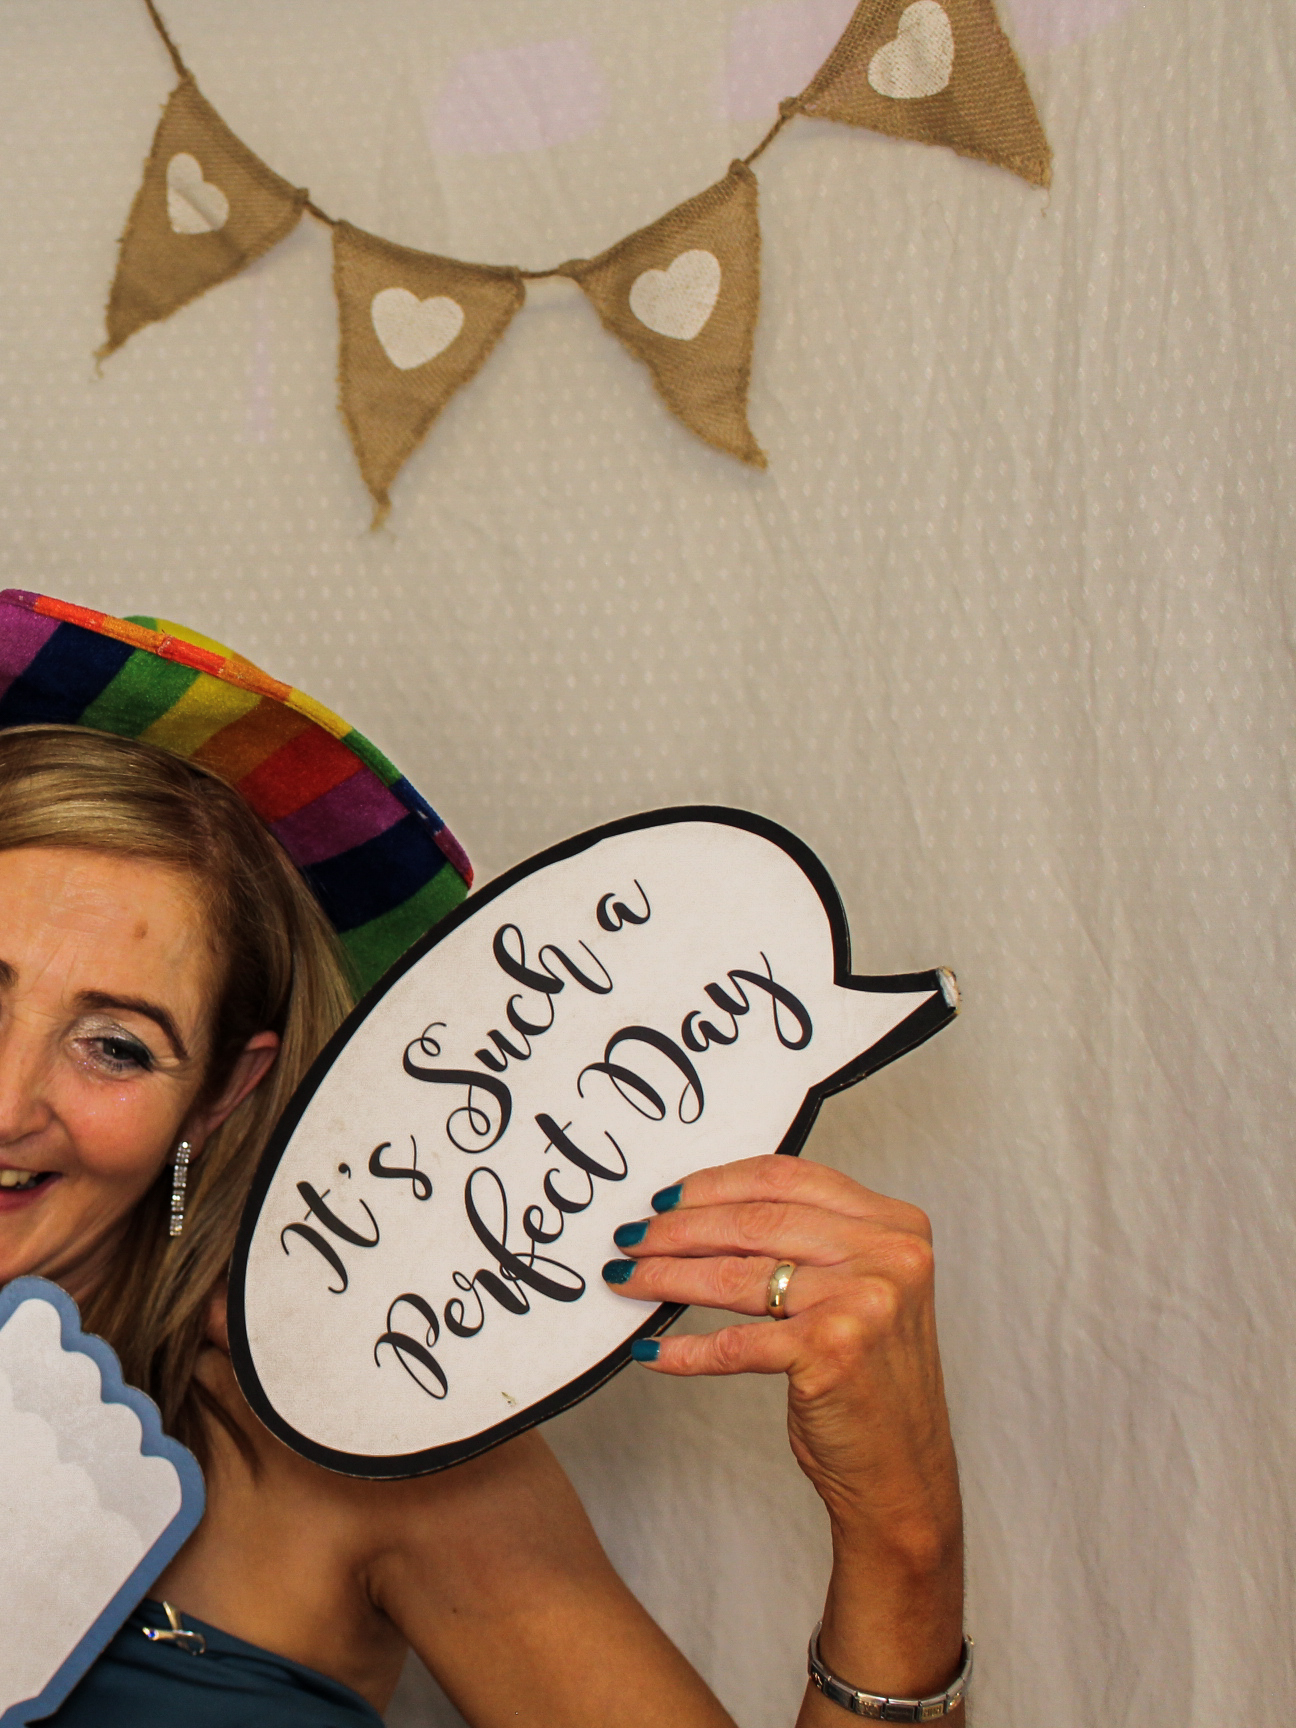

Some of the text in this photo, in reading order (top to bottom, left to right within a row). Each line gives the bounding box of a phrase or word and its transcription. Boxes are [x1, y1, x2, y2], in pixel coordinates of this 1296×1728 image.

[281, 879, 651, 1294] It's Such a
[374, 951, 812, 1400] Perfect Day
